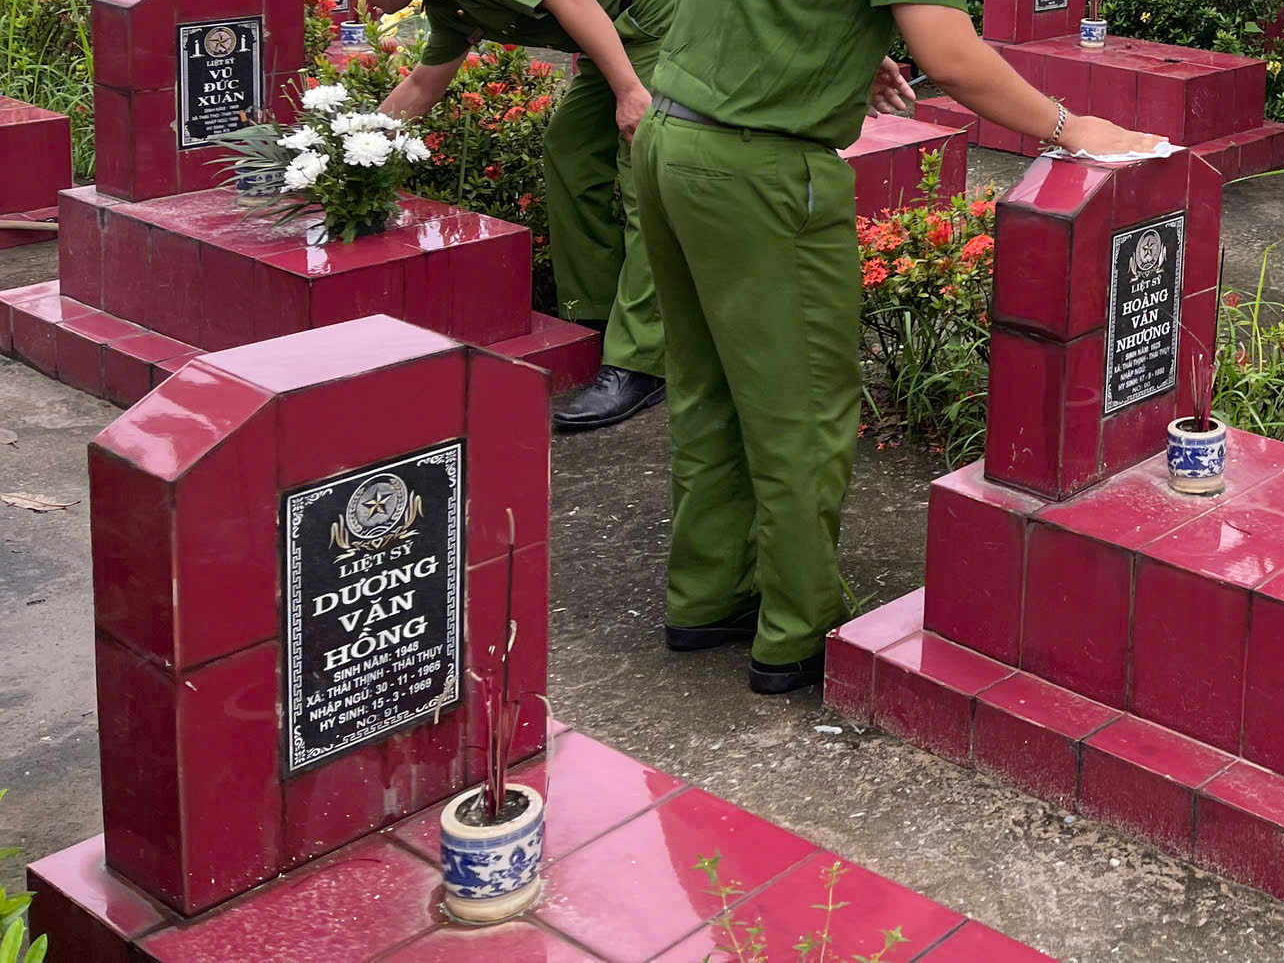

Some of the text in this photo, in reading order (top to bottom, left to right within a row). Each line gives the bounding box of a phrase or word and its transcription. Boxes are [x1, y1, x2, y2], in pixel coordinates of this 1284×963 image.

[203, 78, 240, 93] ĐỨC
[209, 67, 233, 80] VŨ
[197, 90, 245, 107] XUÂN
[1122, 288, 1169, 316] HOÀNG
[1131, 279, 1151, 294] LIỆT
[1131, 308, 1160, 329] VĂN
[1115, 321, 1171, 353] NHƯỢNG
[339, 539, 415, 578] LIỆT SỸ
[312, 555, 440, 617] DƯƠNG
[337, 589, 417, 633] VĂN
[323, 615, 429, 672] HỒNG
[306, 690, 325, 708] XÃ:
[326, 680, 352, 700] THÁI
[353, 669, 384, 689] THỊNH
[391, 654, 416, 673] THÁI
[416, 644, 444, 663] THỤY
[333, 661, 361, 685] SINH
[362, 650, 392, 672] NĂM:
[309, 699, 342, 722] NHẬP
[344, 686, 372, 708] NGŨ:
[374, 682, 388, 696] 30
[396, 673, 408, 686] 11
[319, 716, 336, 733] HY
[338, 705, 369, 724] SINH:
[371, 697, 384, 711] 15
[392, 691, 400, 703] 3
[408, 677, 433, 695] 1969
[383, 705, 399, 718] 91
